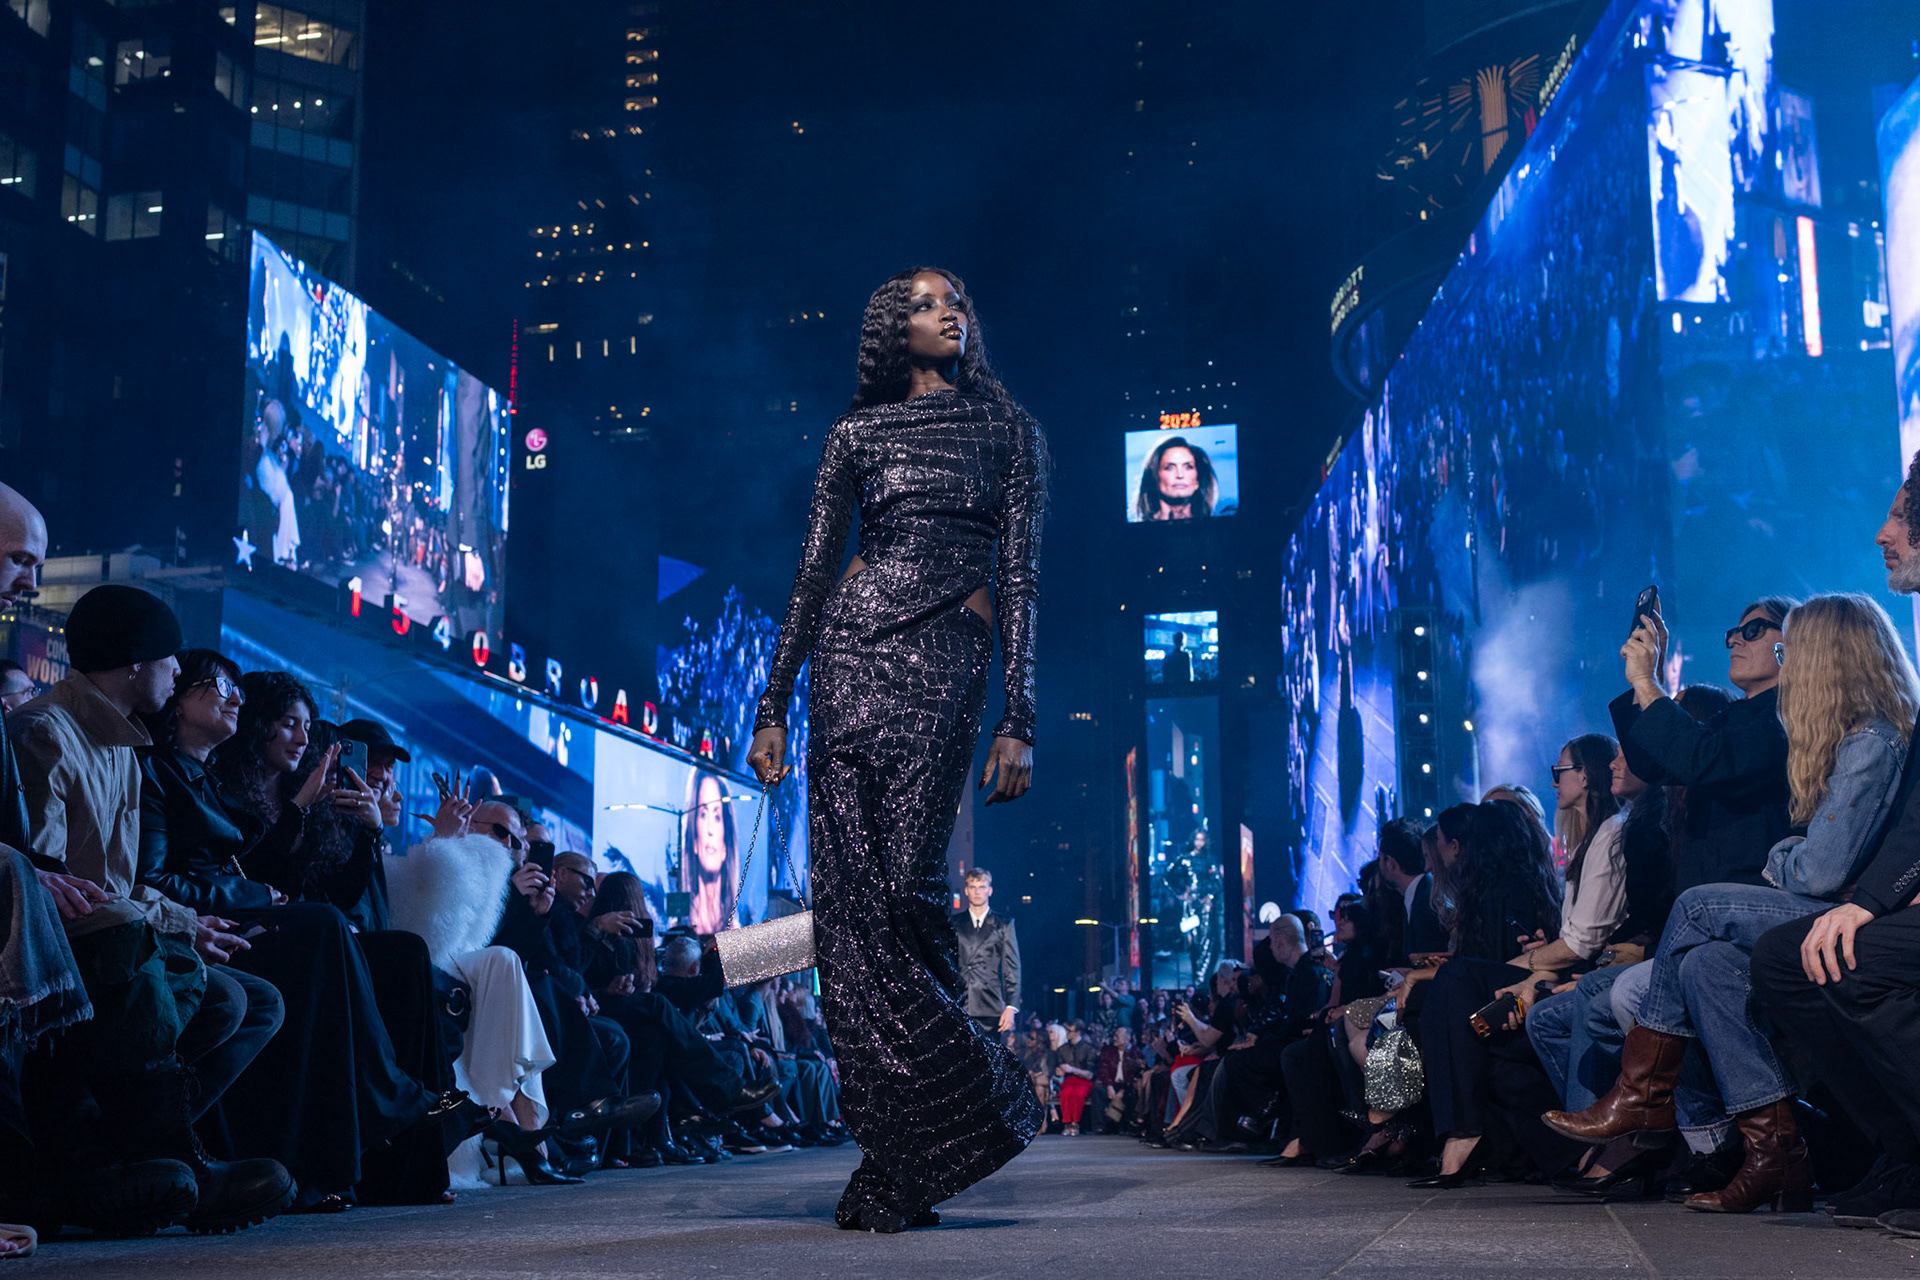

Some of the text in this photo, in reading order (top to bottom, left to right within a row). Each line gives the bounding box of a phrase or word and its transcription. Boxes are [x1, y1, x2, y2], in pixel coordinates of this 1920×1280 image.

[1159, 411, 1201, 430] 2026
[526, 454, 547, 470] LG
[348, 576, 490, 668] 1540
